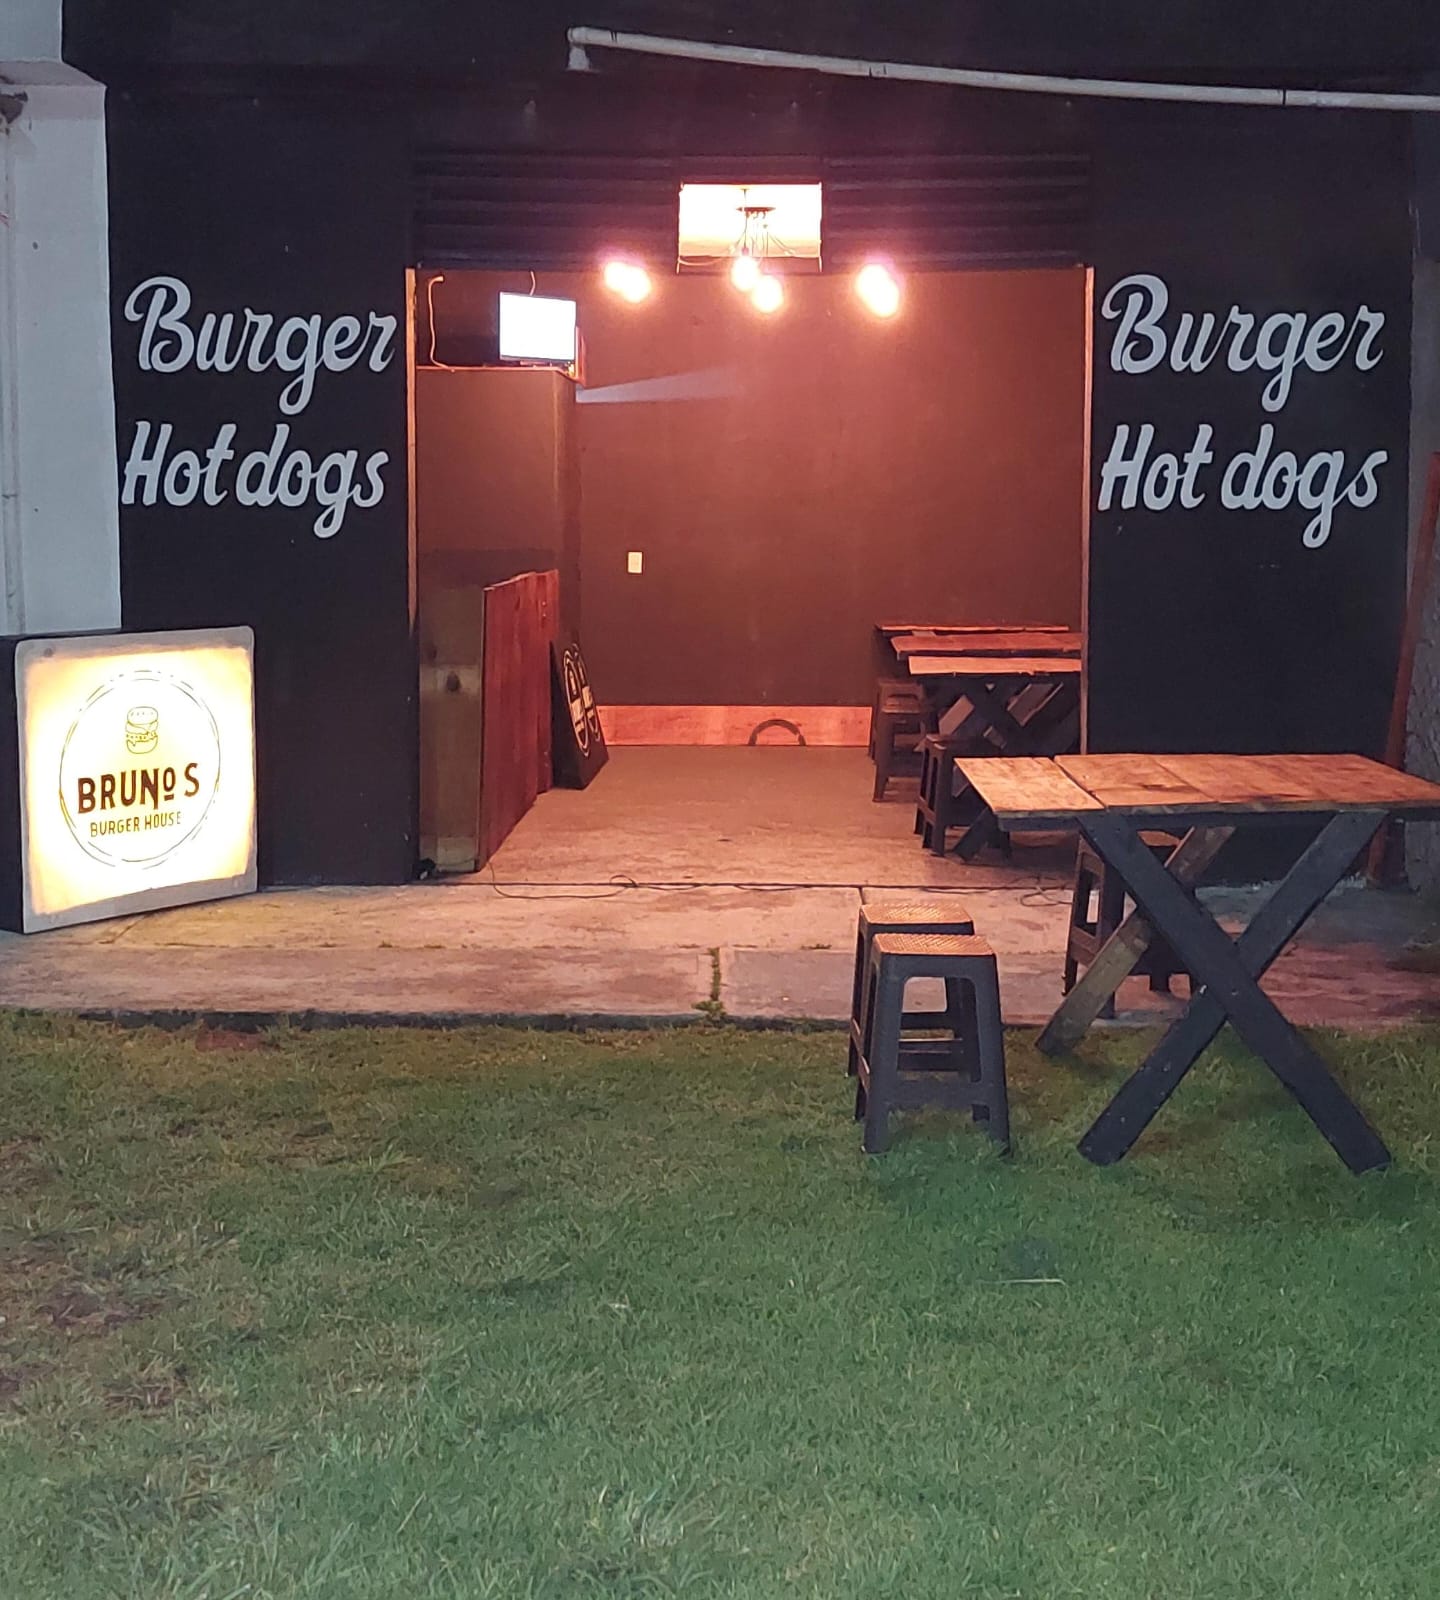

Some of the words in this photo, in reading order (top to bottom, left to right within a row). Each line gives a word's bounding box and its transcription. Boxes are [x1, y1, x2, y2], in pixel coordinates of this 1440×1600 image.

[124, 275, 398, 415] Burger
[1101, 274, 1385, 412] Burger
[1097, 423, 1213, 511] Hot
[1220, 423, 1388, 548] dogs
[90, 816, 140, 838] BURGER
[144, 811, 182, 830] HOUSE
